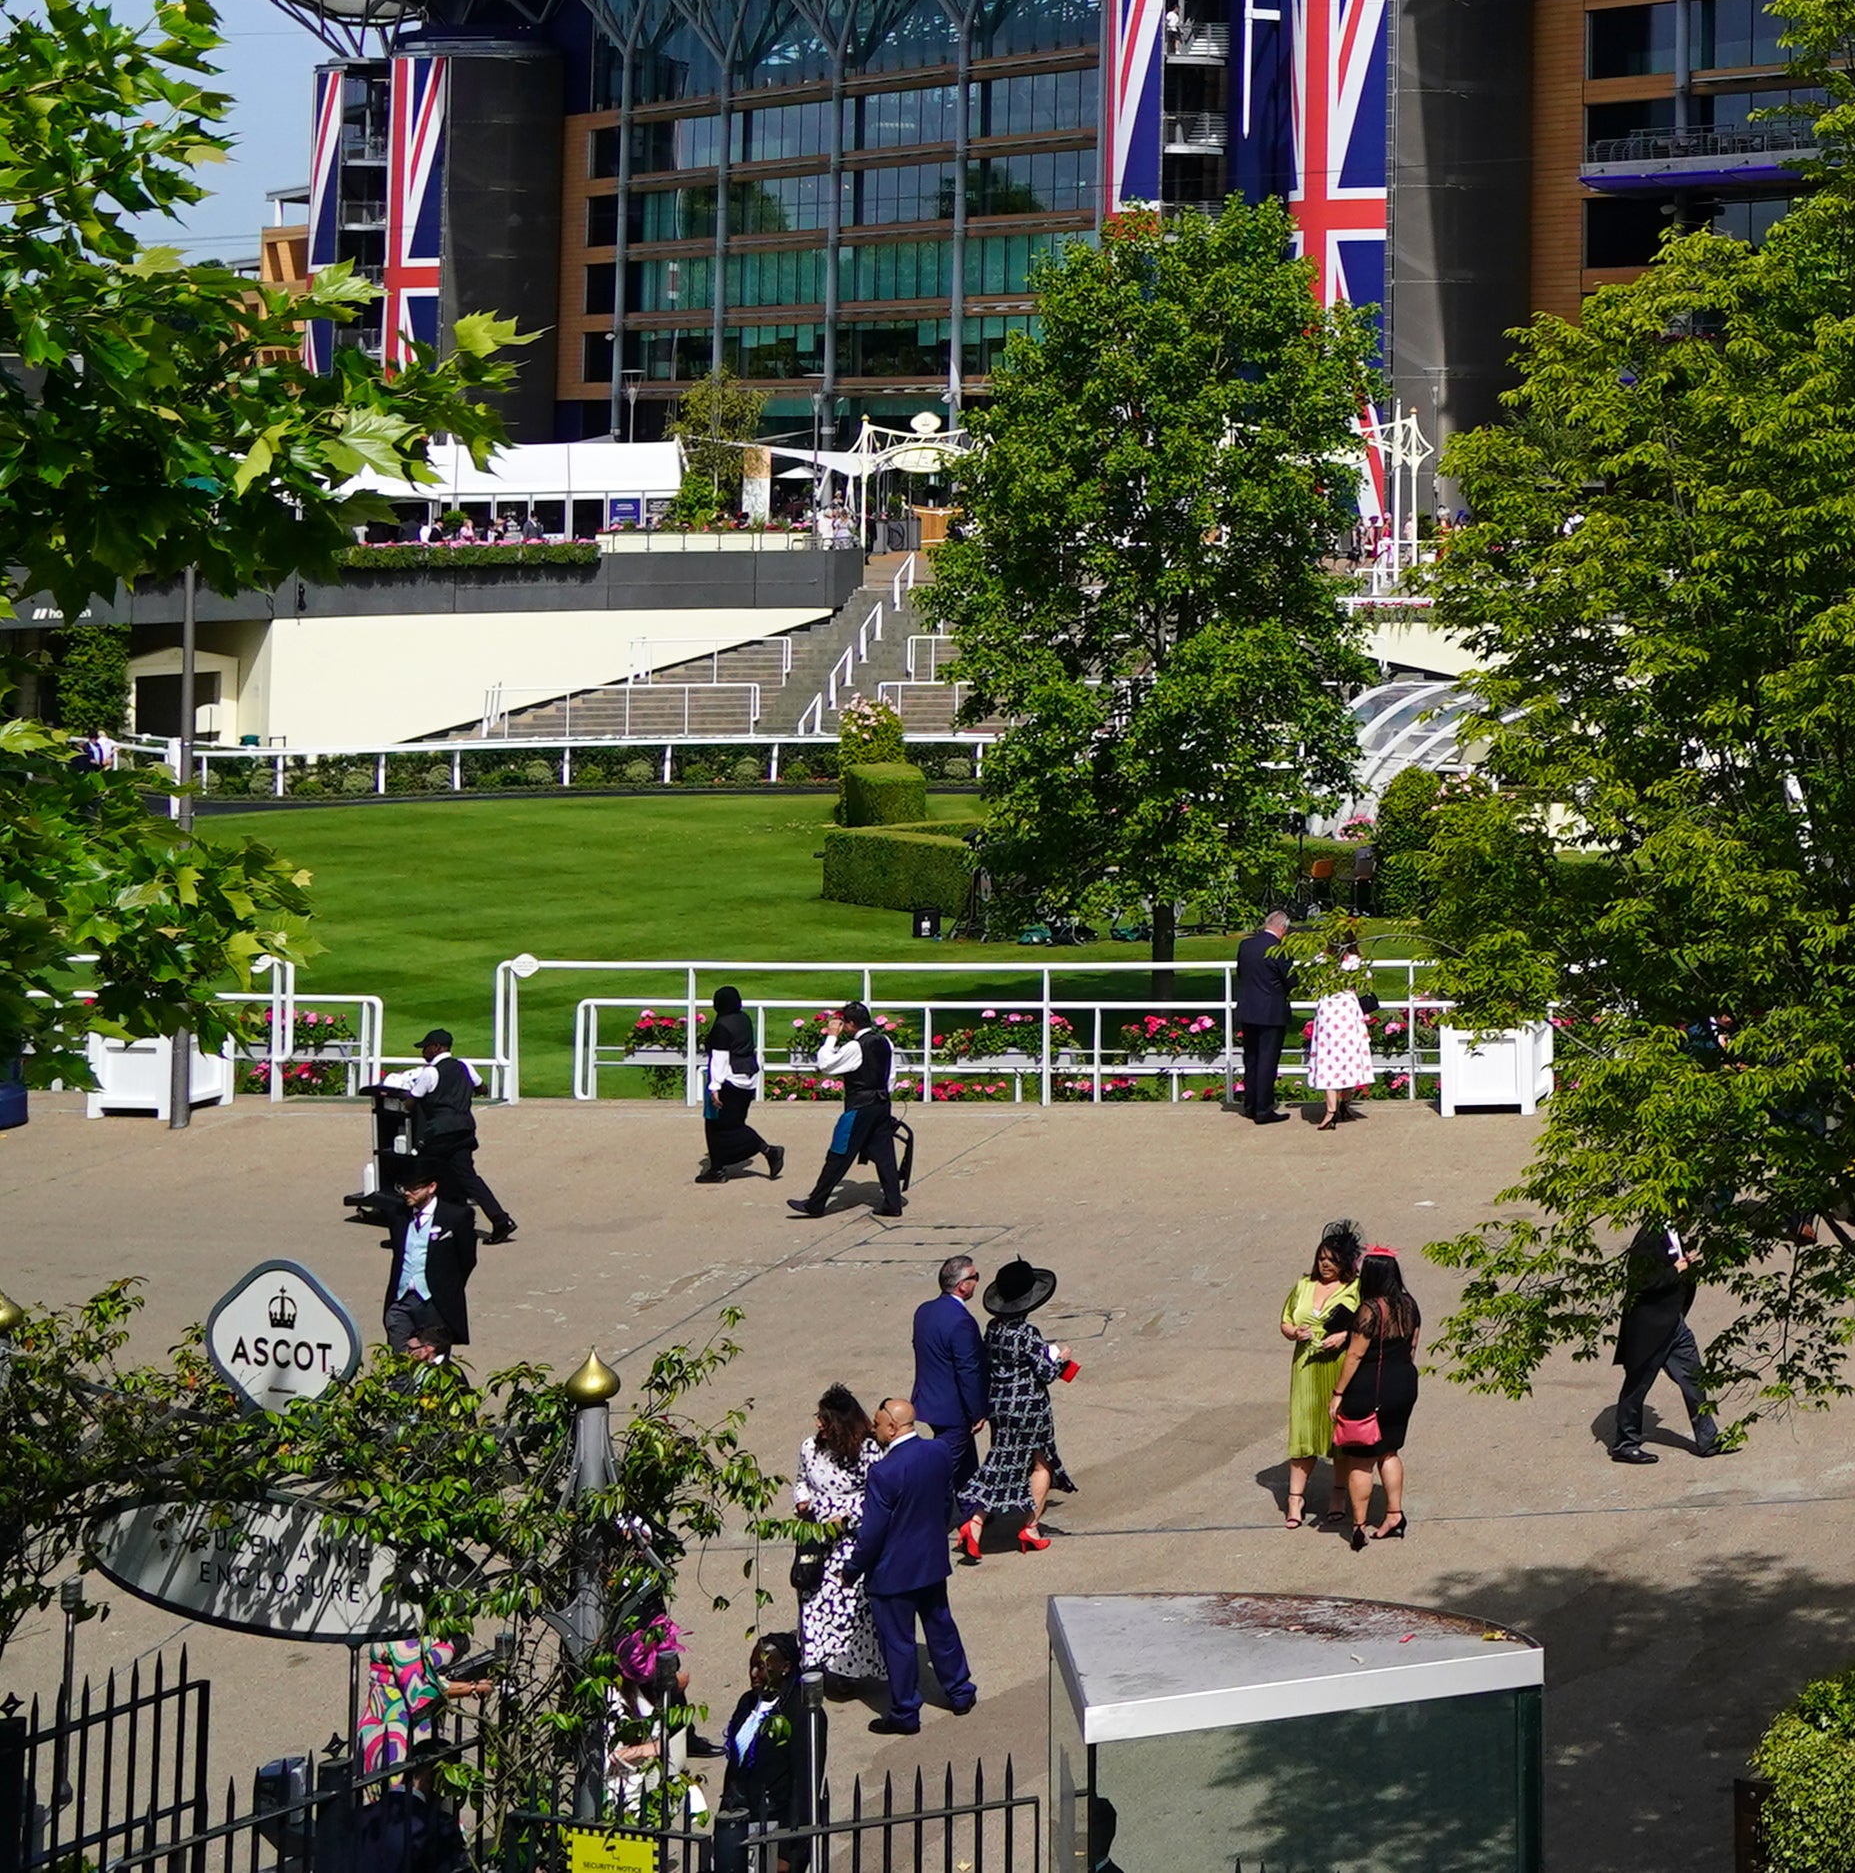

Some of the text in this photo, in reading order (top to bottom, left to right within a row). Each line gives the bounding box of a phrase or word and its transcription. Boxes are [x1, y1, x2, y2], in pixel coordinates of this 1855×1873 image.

[48, 607, 92, 619] hoen
[230, 1335, 332, 1373] ASCOT
[193, 1526, 371, 1572] QUEEN ANNE
[200, 1560, 361, 1604] ENCLOSURE
